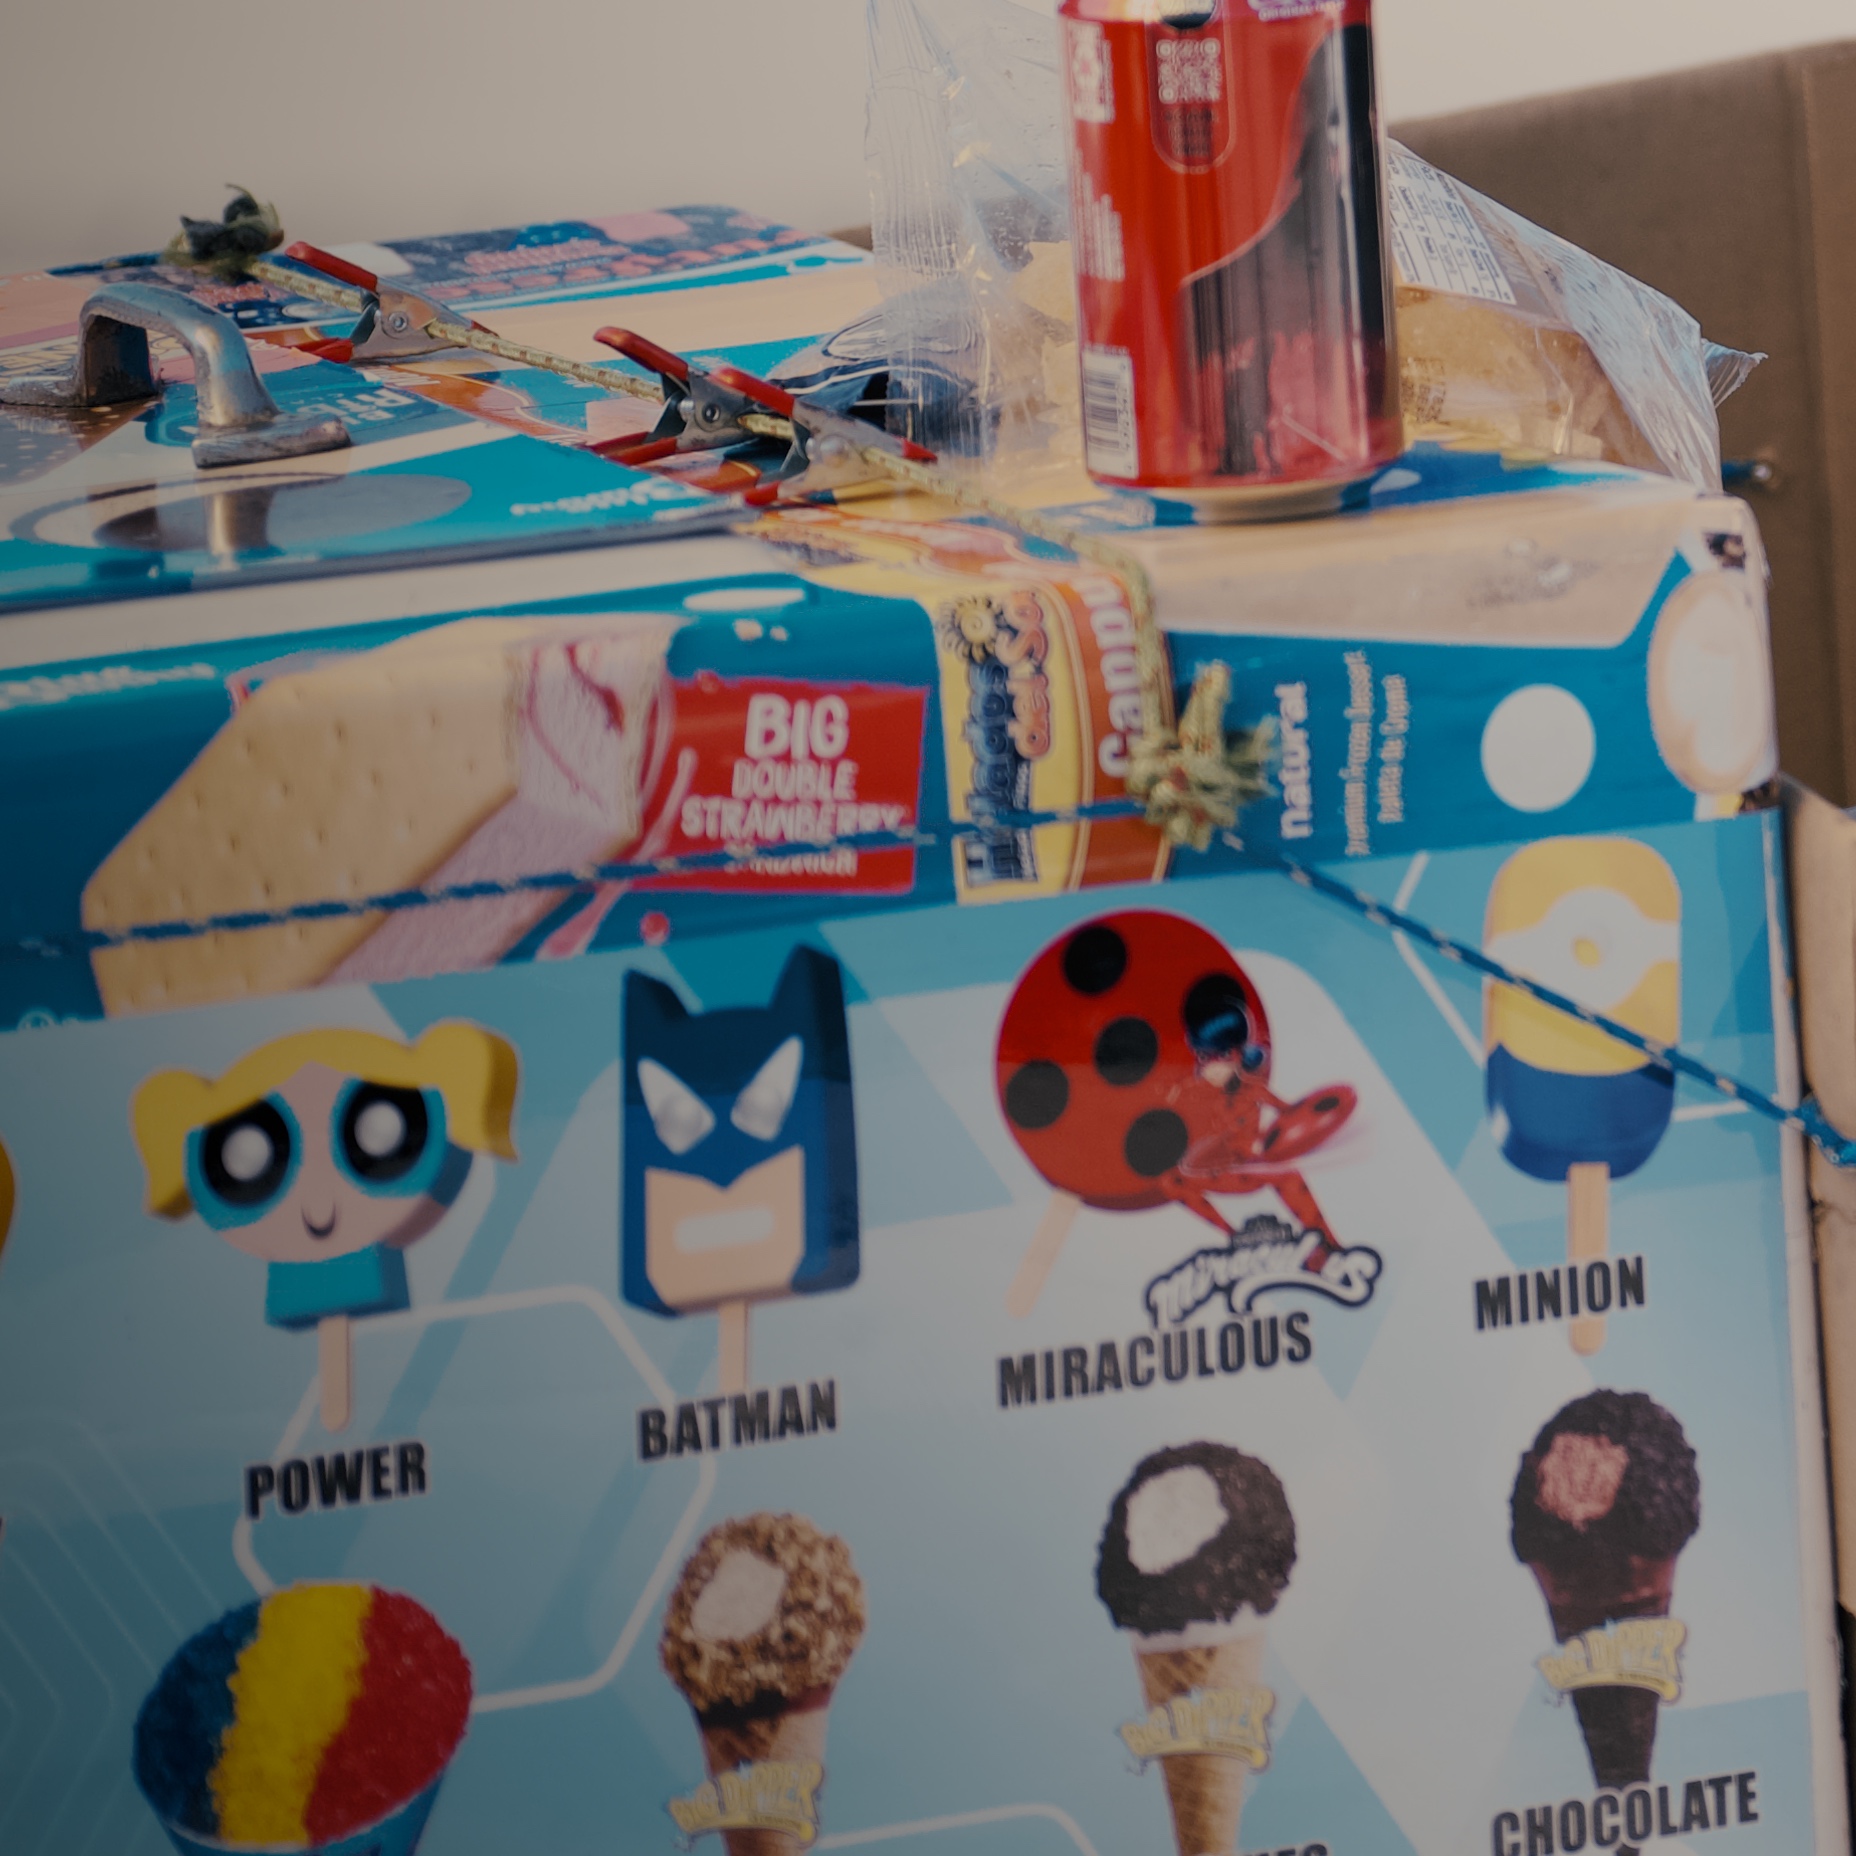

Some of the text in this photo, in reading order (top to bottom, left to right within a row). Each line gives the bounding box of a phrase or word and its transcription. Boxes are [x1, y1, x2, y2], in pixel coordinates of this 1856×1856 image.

[744, 693, 849, 761] BIG
[1274, 681, 1313, 840] natural
[731, 758, 858, 803] DOUBLE
[962, 656, 1022, 887] Hlados
[681, 796, 908, 842] STRAWBERRY
[1476, 1257, 1645, 1330] MINION
[999, 1312, 1312, 1408] MIRACULOUS
[639, 1382, 837, 1460] BATMAN
[245, 1443, 427, 1519] POWER
[1494, 1772, 1759, 1856] CHOCOLATE
